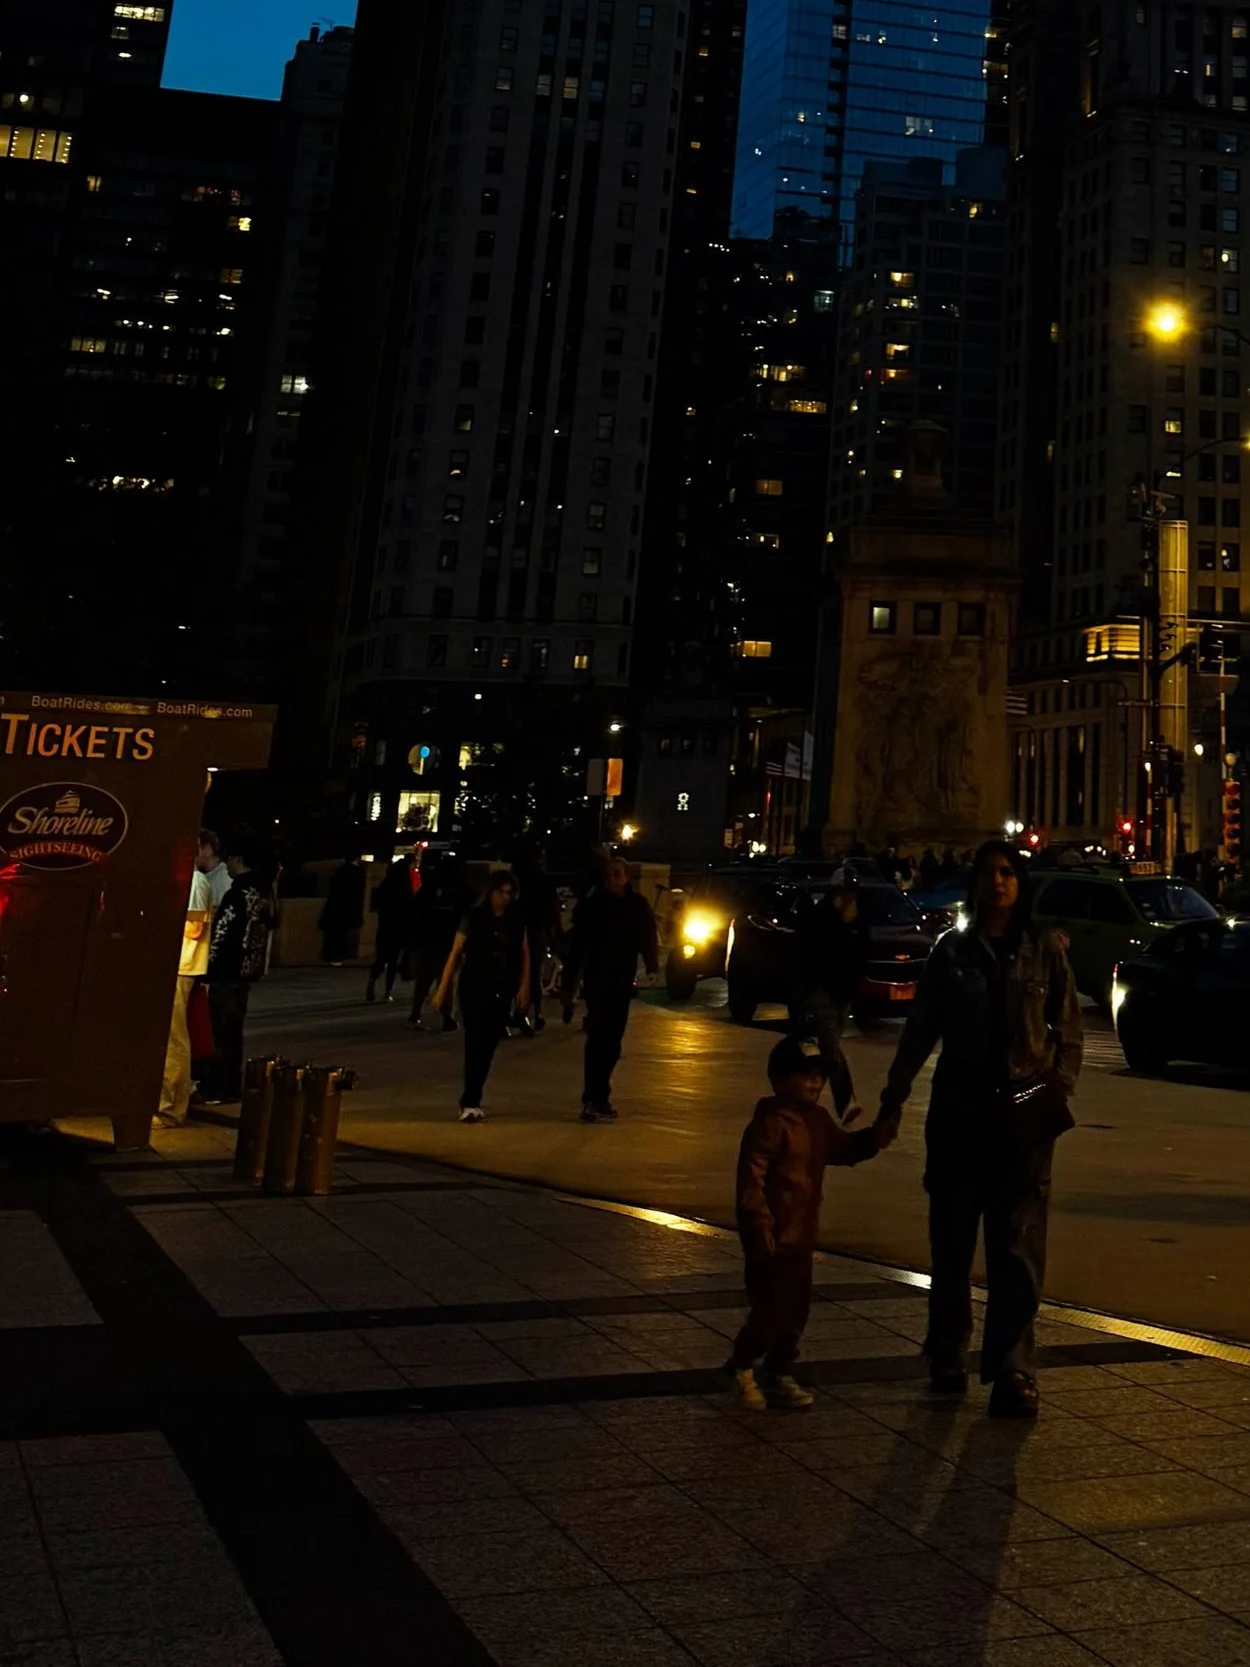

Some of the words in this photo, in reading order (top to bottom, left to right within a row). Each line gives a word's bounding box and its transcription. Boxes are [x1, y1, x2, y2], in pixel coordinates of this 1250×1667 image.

[31, 694, 133, 712] BoatRides.com
[156, 701, 253, 718] BoatRides.com
[0, 713, 156, 761] TICKETS
[7, 806, 115, 836] Shoreline
[9, 841, 101, 863] SIGHTSEEING
